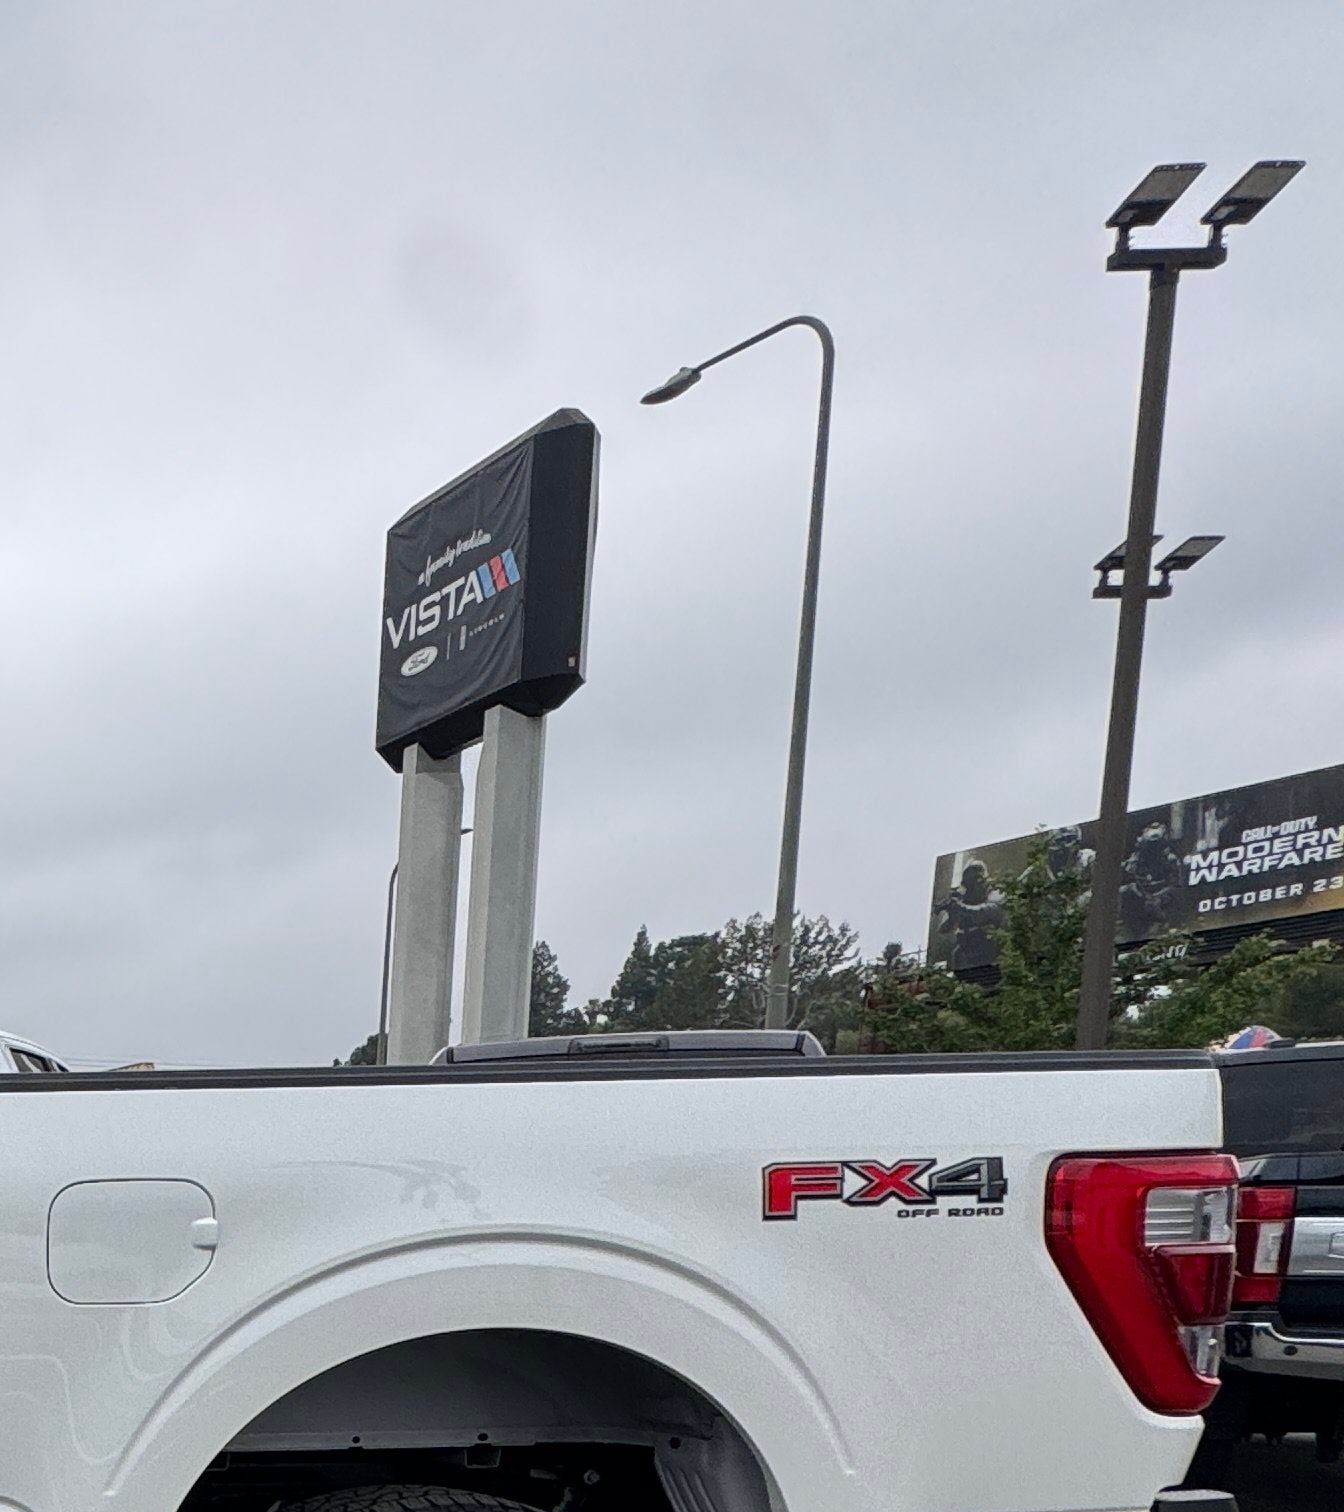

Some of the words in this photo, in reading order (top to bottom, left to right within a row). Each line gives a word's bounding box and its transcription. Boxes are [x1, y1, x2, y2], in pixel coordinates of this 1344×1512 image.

[386, 570, 484, 650] VISTA
[1188, 842, 1344, 886] WARFARE
[1190, 825, 1344, 870] MODERN
[1198, 882, 1304, 913] OCTOBER
[1312, 875, 1344, 893] 23
[762, 1156, 1008, 1221] FX4
[897, 1208, 940, 1218] OFF
[947, 1206, 1004, 1217] ROAD
